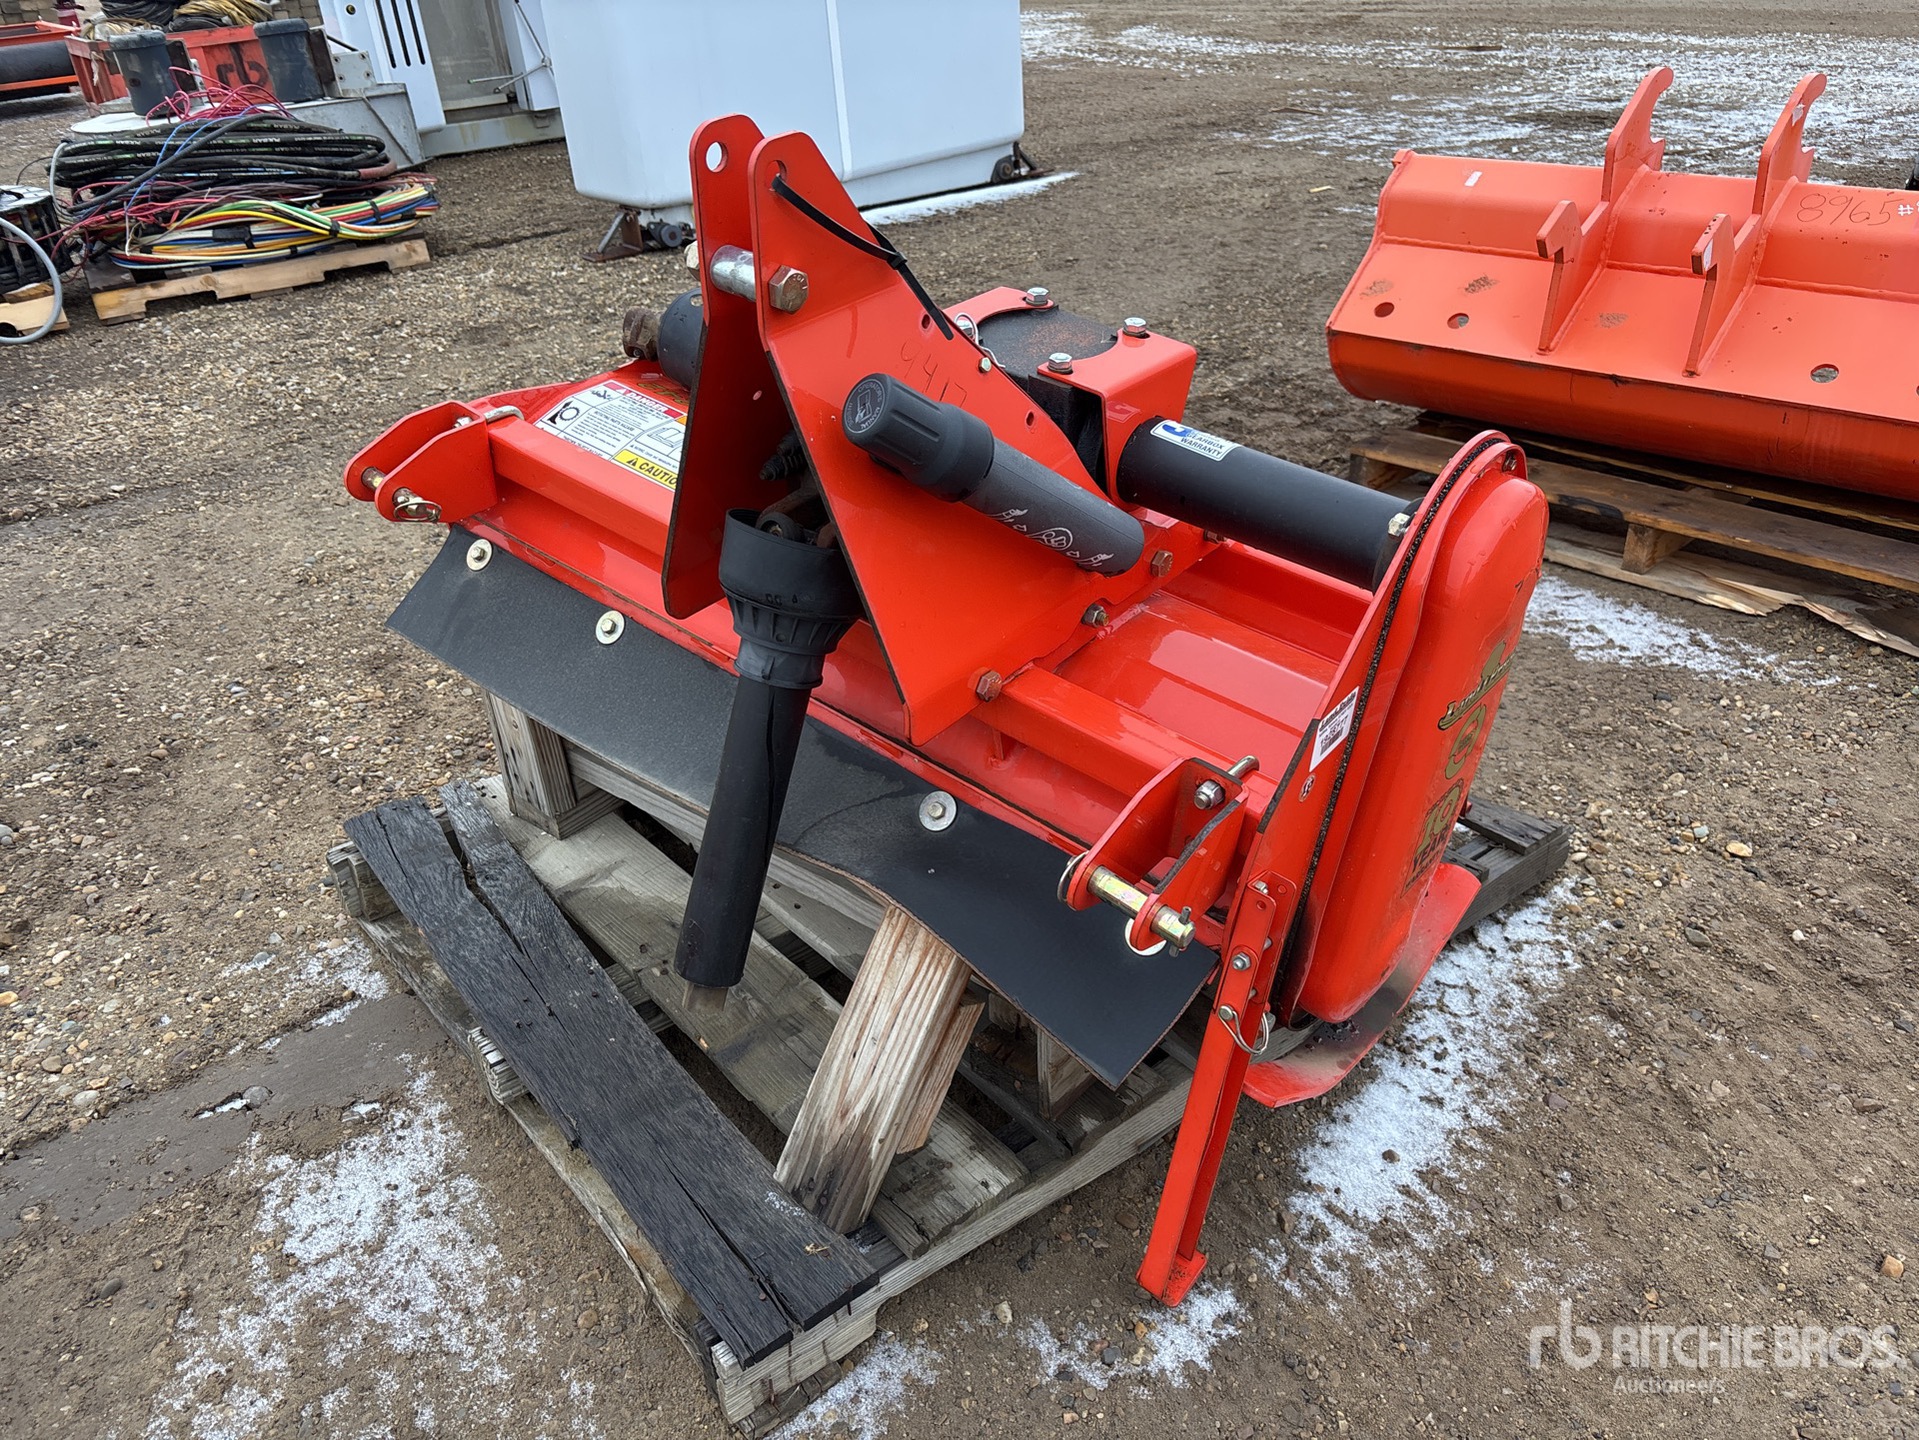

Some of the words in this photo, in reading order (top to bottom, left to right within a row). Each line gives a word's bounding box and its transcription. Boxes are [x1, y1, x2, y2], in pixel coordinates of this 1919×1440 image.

[1796, 193, 1905, 226] 8965
[626, 390, 670, 415] DANGER
[1180, 437, 1222, 456] WARRANTY
[1186, 432, 1225, 450] GEARBOX
